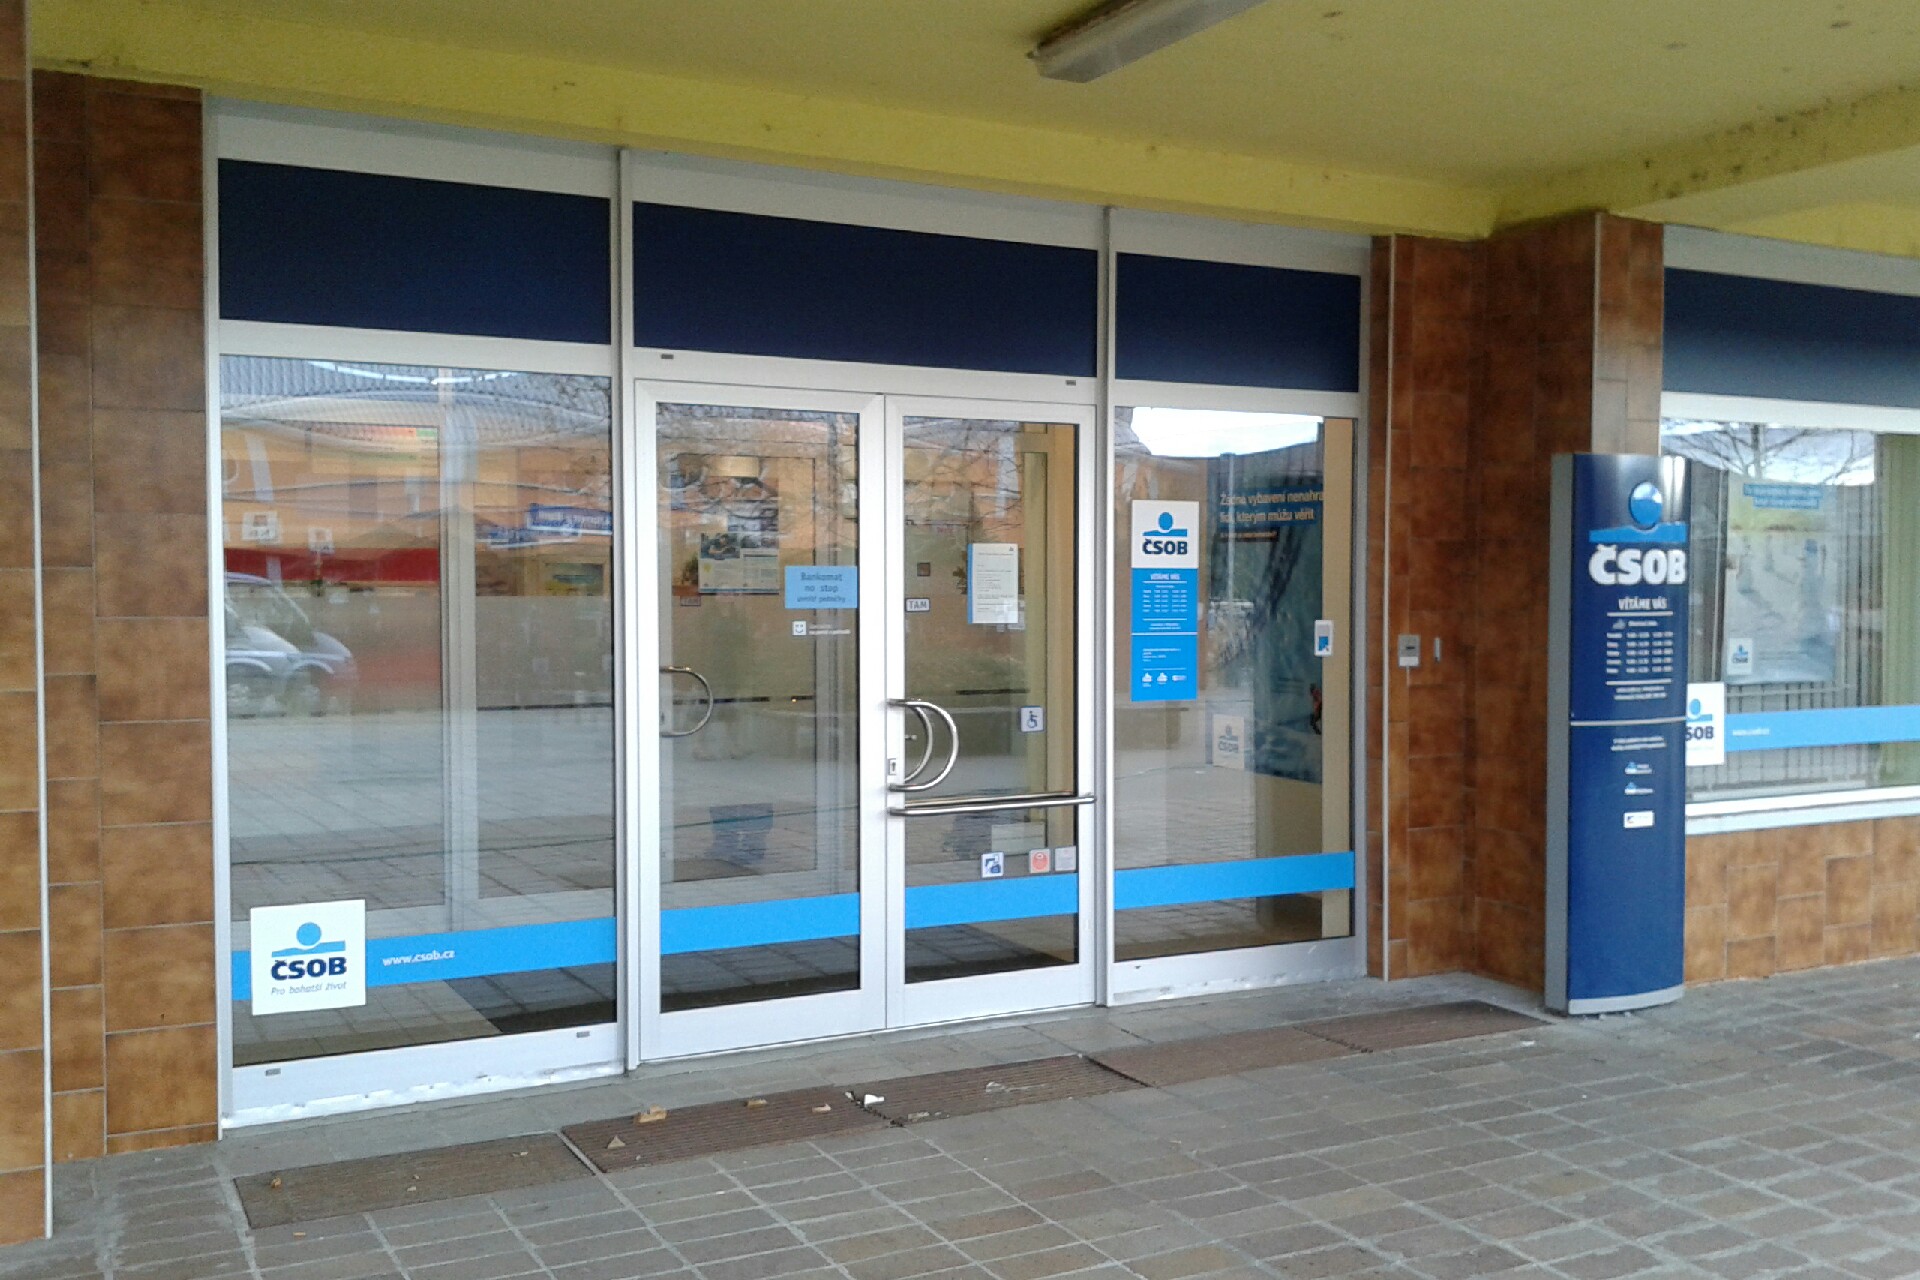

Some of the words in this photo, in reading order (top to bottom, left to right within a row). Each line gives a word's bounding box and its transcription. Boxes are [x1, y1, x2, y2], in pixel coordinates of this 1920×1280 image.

[1142, 538, 1188, 555] ČSOB
[1588, 543, 1686, 585] ČSOB
[801, 572, 843, 581] Bankomat
[820, 584, 839, 593] stop
[908, 600, 927, 609] TAM
[1685, 726, 1714, 741] SOB
[382, 949, 456, 967] www.csob.cz
[270, 956, 347, 981] ČSOB
[271, 986, 286, 996] Pro
